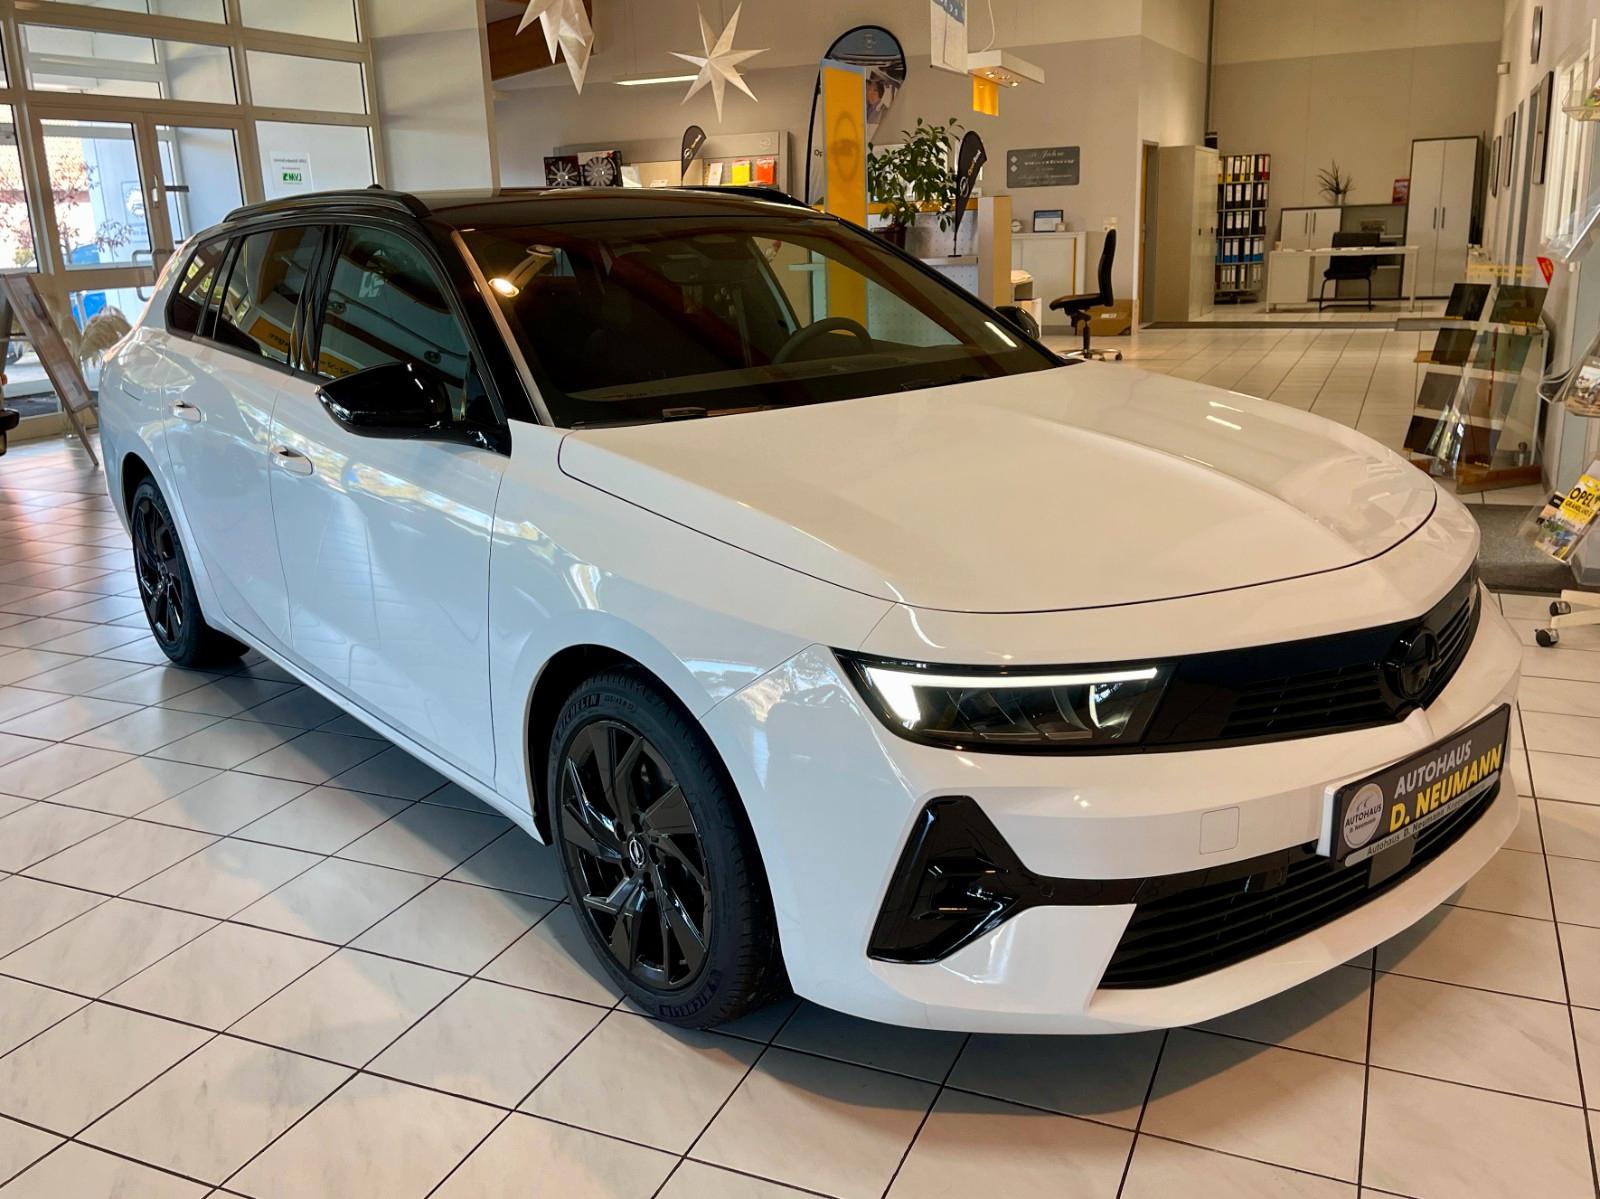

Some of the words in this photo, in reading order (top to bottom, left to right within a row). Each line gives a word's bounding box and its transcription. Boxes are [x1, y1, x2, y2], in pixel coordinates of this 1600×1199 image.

[1569, 487, 1595, 508] OPEL
[1394, 739, 1472, 799] AUTOHAUS
[1389, 802, 1410, 833] D.
[1415, 743, 1502, 819] NEUMANN
[1345, 803, 1383, 827] AUTOHAUS
[1366, 834, 1400, 856] Autohaus
